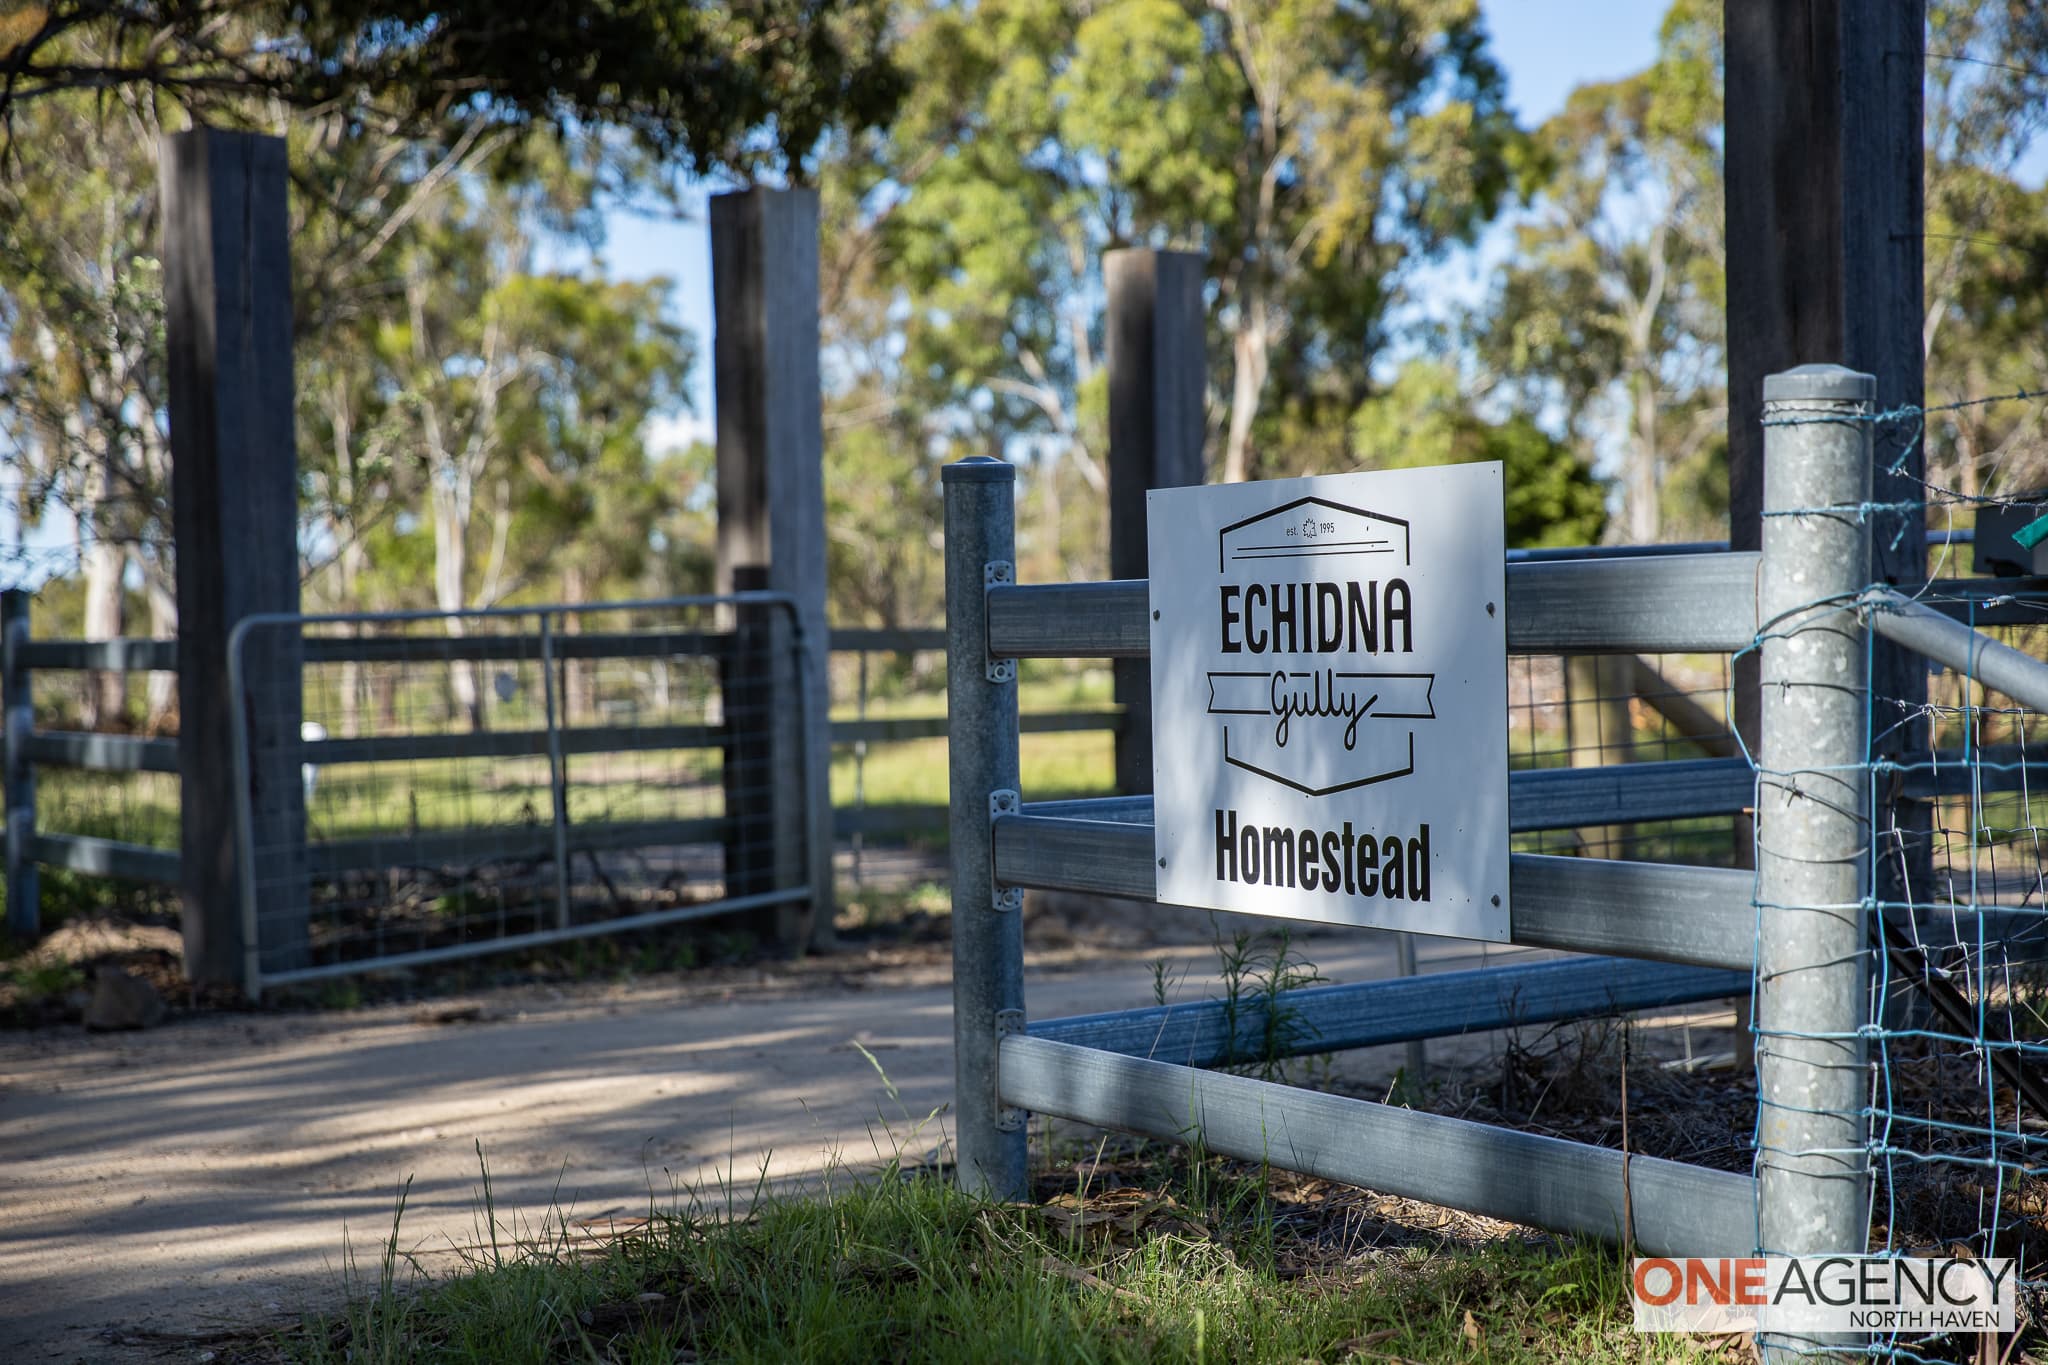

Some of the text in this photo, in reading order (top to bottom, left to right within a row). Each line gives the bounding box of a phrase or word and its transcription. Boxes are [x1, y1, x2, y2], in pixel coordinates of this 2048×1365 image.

[1286, 522, 1335, 536] est. 1995
[1220, 578, 1413, 653] ECHIDNA
[1270, 668, 1378, 750] Gully
[1215, 809, 1431, 902] Homestead
